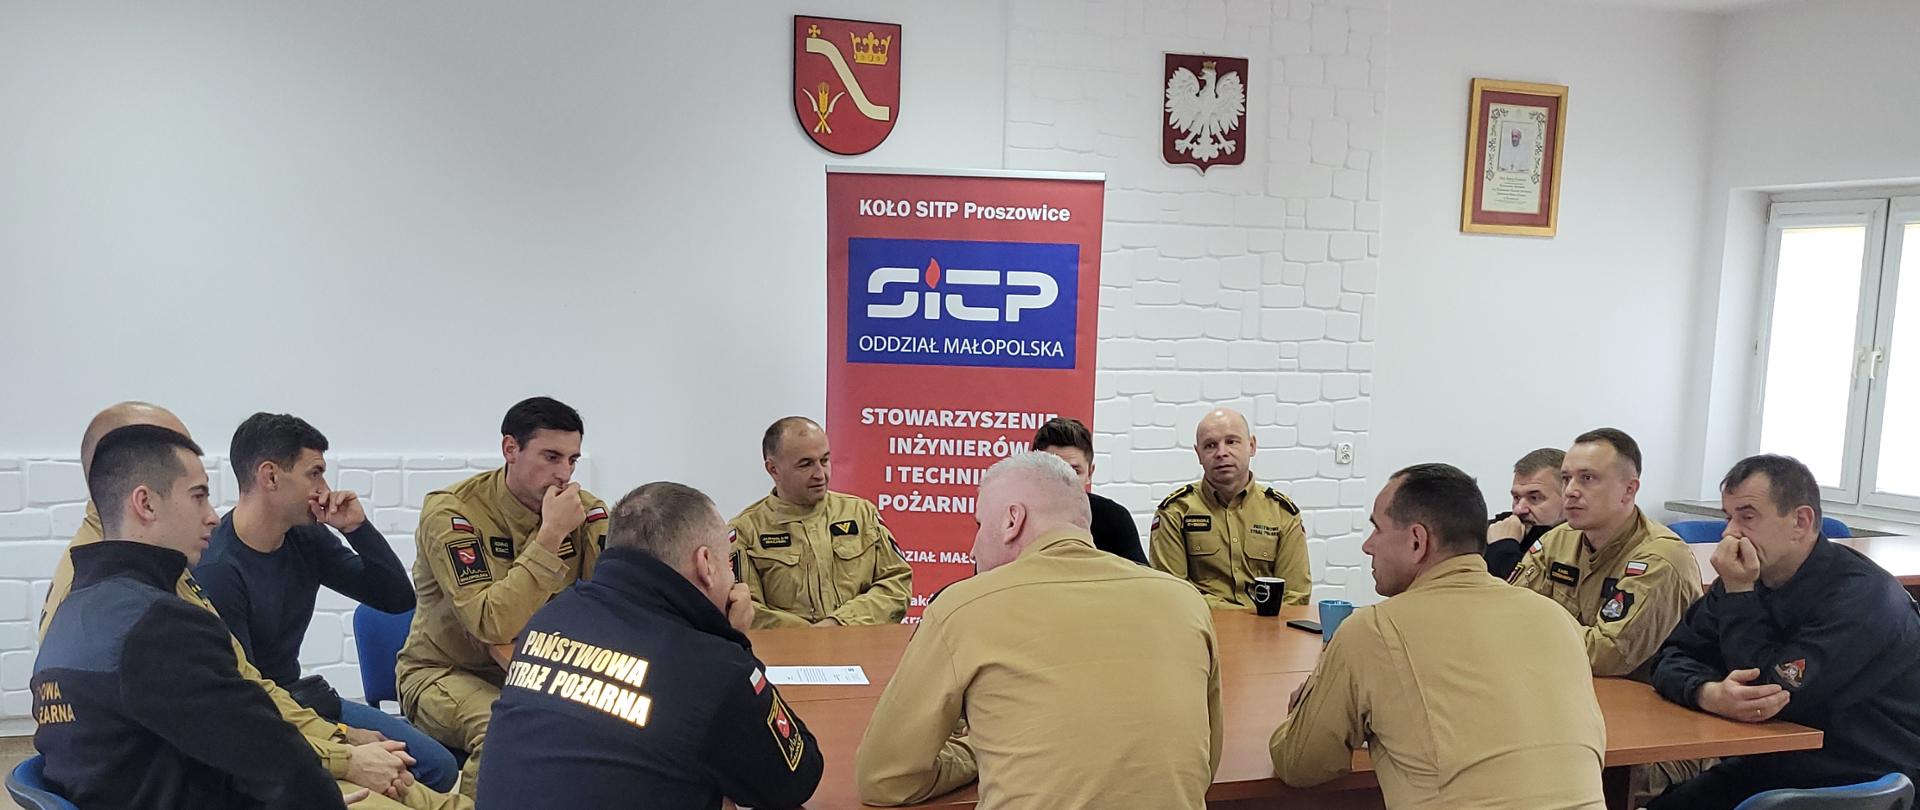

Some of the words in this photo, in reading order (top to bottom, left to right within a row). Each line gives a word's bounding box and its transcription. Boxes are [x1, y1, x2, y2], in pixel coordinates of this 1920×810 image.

[859, 199, 911, 217] KOŁO
[915, 201, 959, 218] SITP
[964, 202, 1071, 222] Proszowice
[859, 335, 940, 354] ODDZIAŁ
[944, 337, 1064, 358] MAŁOPOLSKA
[889, 433, 1030, 458] INŻYNIERÓW
[885, 467, 892, 483] I
[897, 467, 987, 487] TECHNI
[878, 491, 975, 514] POŻARNI
[901, 550, 937, 563] ZIAŁ
[521, 630, 649, 688] PAŃSTWOWA
[505, 660, 552, 692] STRAŻ
[548, 670, 651, 727] POŻARNA
